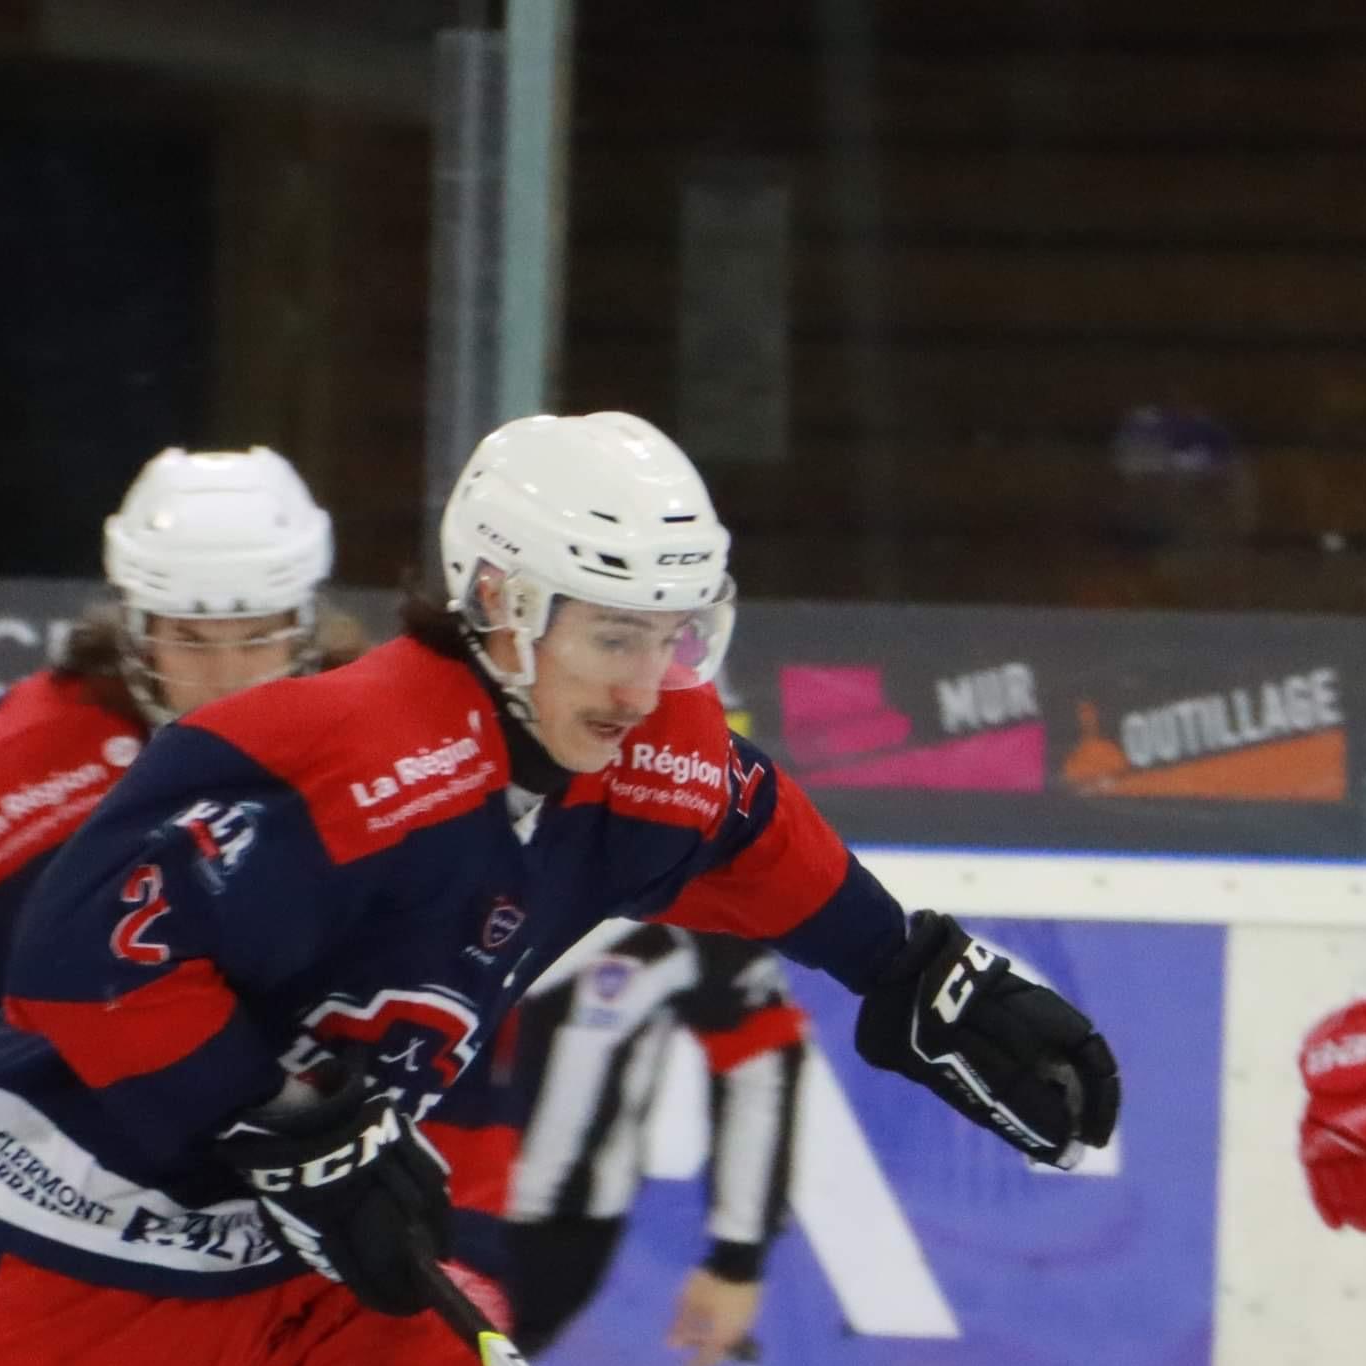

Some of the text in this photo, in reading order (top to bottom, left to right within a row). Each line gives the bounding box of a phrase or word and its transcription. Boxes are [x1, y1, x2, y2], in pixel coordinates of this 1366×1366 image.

[1121, 668, 1343, 769] OUTILLAGE
[349, 776, 400, 808] La
[393, 736, 481, 785] Région
[631, 743, 723, 790] Région
[109, 863, 172, 966] 2
[251, 1106, 403, 1192] CCM
